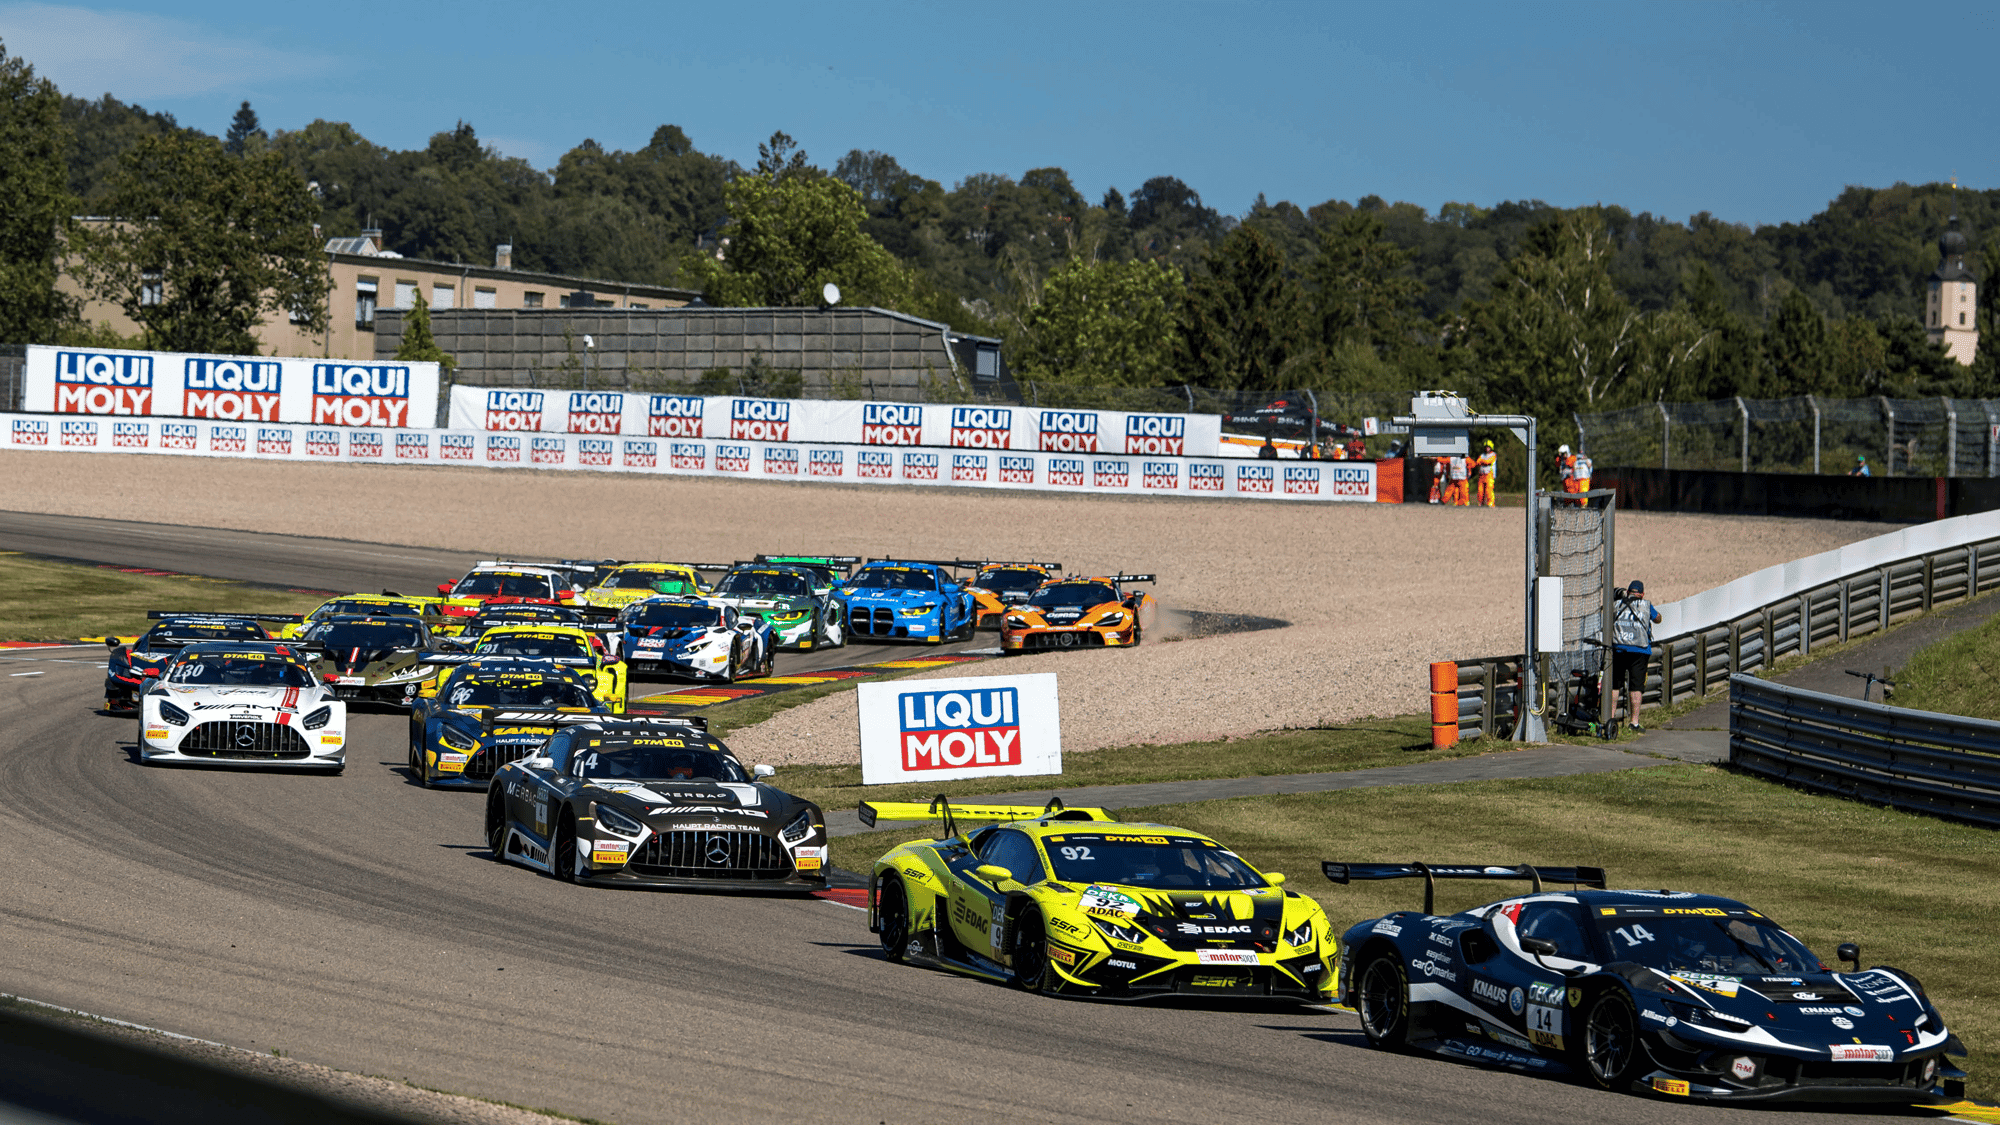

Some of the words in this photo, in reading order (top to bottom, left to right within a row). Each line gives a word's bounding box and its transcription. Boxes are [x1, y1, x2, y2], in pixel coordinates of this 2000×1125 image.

[59, 354, 149, 385] LIQUI
[188, 360, 279, 392] LIQUI
[317, 366, 407, 396] LIQUI
[58, 385, 150, 415] MOLY
[187, 391, 279, 421] MOLY
[489, 392, 542, 411] LIQUI
[571, 394, 621, 412] LIQUI
[315, 397, 407, 427] MOLY
[651, 396, 702, 417] LIQUI
[733, 398, 788, 421] LIQUI
[488, 411, 540, 431] MOLY
[865, 405, 920, 425] LIQUI
[953, 409, 1009, 429] LIQUI
[14, 421, 47, 432] LIQUI
[62, 423, 97, 434] LIQUI
[568, 413, 620, 434] MOLY
[649, 417, 702, 438] MOLY
[1041, 413, 1096, 433] LIQUI
[1128, 416, 1183, 436] LIQUI
[115, 424, 147, 435] LIQUI
[162, 426, 196, 437] LIQUI
[213, 428, 245, 438] LIQUI
[259, 430, 291, 441] LIQUI
[731, 420, 788, 441] MOLY
[863, 425, 920, 445] MOLY
[12, 433, 47, 444] MOLY
[60, 435, 97, 446] MOLY
[113, 436, 147, 447] MOLY
[160, 438, 196, 449] MOLY
[307, 432, 338, 443] LIQUI
[351, 434, 381, 444] LIQUI
[397, 435, 427, 446] LIQUI
[442, 436, 473, 447] LIQUI
[488, 437, 518, 448] LIQUI
[951, 428, 1010, 449] MOLY
[1040, 433, 1096, 452] MOLY
[211, 439, 245, 450] MOLY
[257, 442, 291, 453] MOLY
[305, 444, 338, 455] MOLY
[349, 445, 381, 456] MOLY
[533, 439, 563, 450] LIQUI
[580, 441, 611, 452] LIQUI
[625, 443, 656, 454] LIQUI
[672, 445, 704, 456] LIQUI
[1125, 437, 1182, 455] MOLY
[395, 447, 427, 458] MOLY
[440, 448, 473, 459] MOLY
[486, 449, 518, 460] MOLY
[531, 451, 563, 462] MOLY
[717, 446, 749, 458] LIQUI
[766, 449, 797, 460] LIQUI
[811, 451, 842, 463] LIQUI
[578, 453, 611, 464] MOLY
[623, 455, 656, 466] MOLY
[670, 457, 704, 468] MOLY
[715, 459, 749, 470] MOLY
[859, 453, 891, 464] LIQUI
[904, 454, 937, 467] LIQUI
[954, 456, 986, 468] LIQUI
[1001, 458, 1033, 470] LIQUI
[764, 461, 797, 472] MOLY
[809, 464, 842, 475] MOLY
[859, 465, 891, 477] MOLY
[904, 466, 937, 478] MOLY
[1050, 460, 1082, 473] LIQUI
[1094, 462, 1128, 474] LIQUI
[1144, 463, 1177, 475] LIQUI
[1190, 465, 1223, 477] LIQUI
[953, 468, 986, 480] MOLY
[1000, 470, 1033, 482] MOLY
[1049, 472, 1083, 485] MOLY
[1239, 467, 1272, 479] LIQUI
[1285, 469, 1318, 480] LIQUI
[1335, 470, 1368, 482] LIQUI
[1095, 474, 1127, 486] MOLY
[1144, 476, 1177, 488] MOLY
[1190, 477, 1223, 490] MOLY
[1238, 479, 1272, 492] MOLY
[1285, 481, 1318, 493] MOLY
[1335, 482, 1368, 494] MOLY
[482, 644, 499, 654] 91
[174, 664, 204, 678] 130
[905, 691, 1014, 728] LIQUI
[603, 731, 702, 739] MERBAG
[907, 729, 1018, 768] MOLY
[585, 753, 598, 770] 4
[660, 791, 727, 799] MERBAG
[1061, 846, 1095, 860] 92
[903, 868, 926, 880] SSR
[1096, 899, 1125, 909] 92
[1087, 907, 1125, 918] ADAC
[965, 908, 988, 934] EDAG
[1050, 917, 1079, 934] SSR
[1615, 924, 1655, 947] 14
[1108, 959, 1137, 970] MOTUL
[1210, 953, 1259, 964] motorsport
[1472, 979, 1507, 1003] KNAUS
[1528, 983, 1566, 1006] DEKRA
[1536, 1009, 1552, 1031] 14
[1641, 1009, 1667, 1023] Allianz
[1535, 1030, 1557, 1049] ADAC
[1844, 1049, 1893, 1060] motorsport
